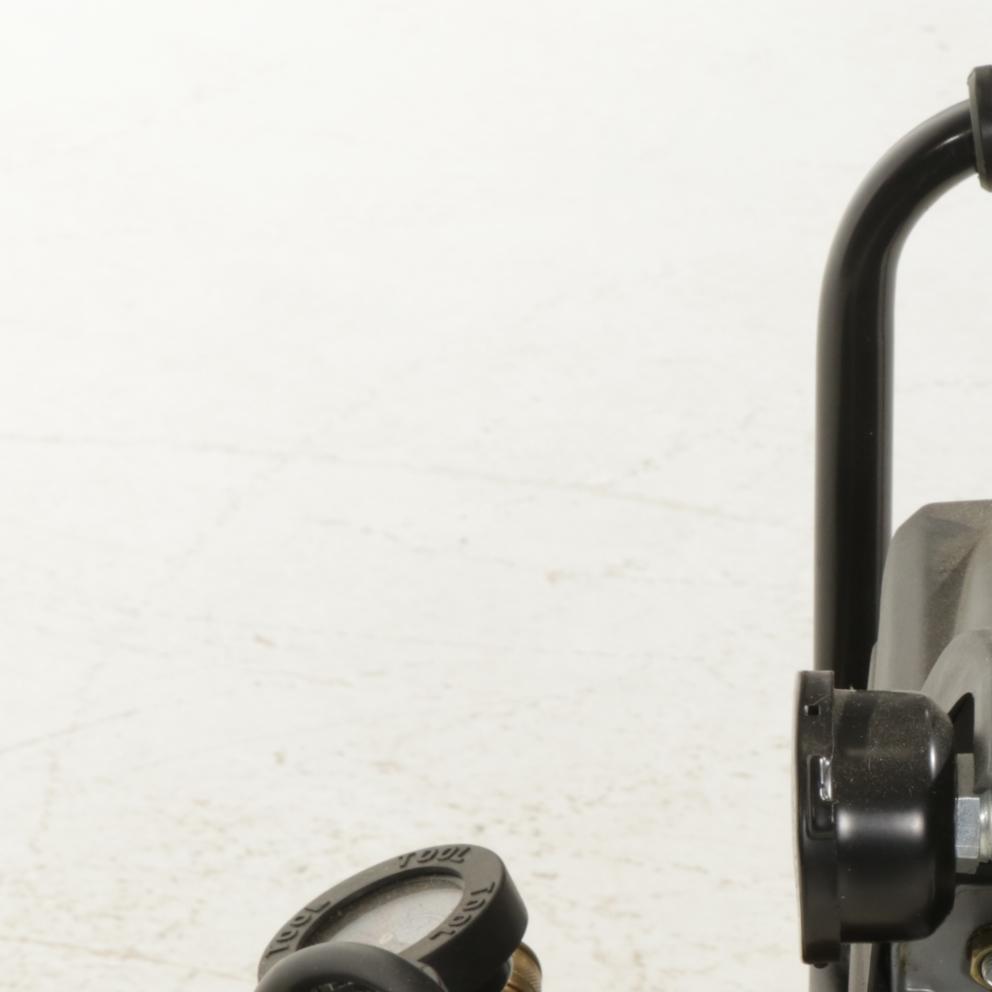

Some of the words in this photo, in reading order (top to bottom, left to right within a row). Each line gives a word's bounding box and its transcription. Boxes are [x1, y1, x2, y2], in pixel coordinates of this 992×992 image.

[398, 845, 471, 869] TOOL
[265, 900, 331, 959] TOOL
[430, 881, 496, 941] TOOL
